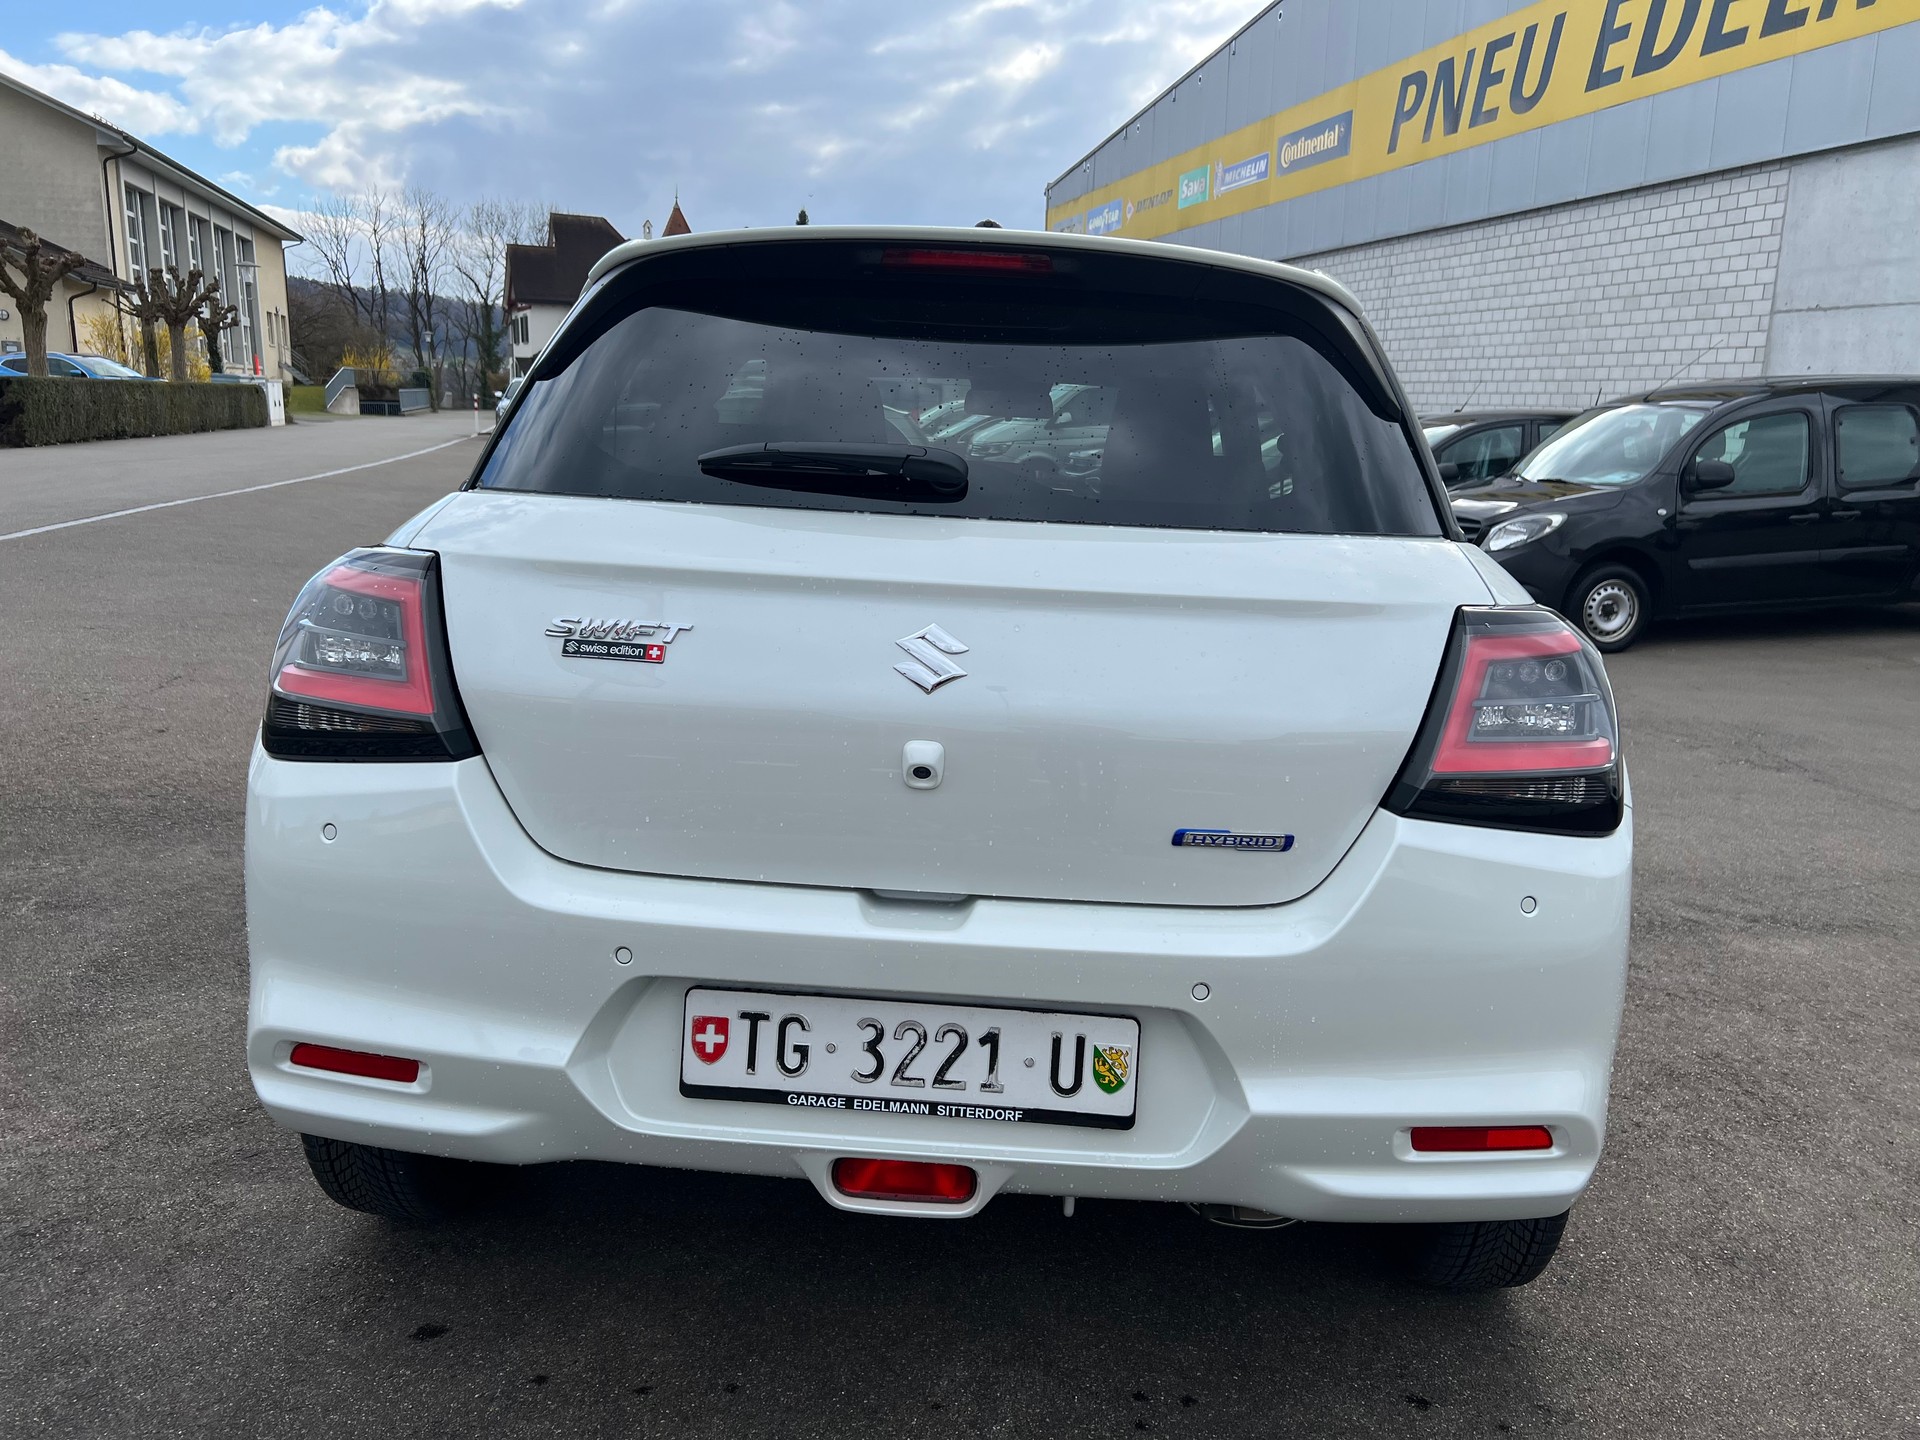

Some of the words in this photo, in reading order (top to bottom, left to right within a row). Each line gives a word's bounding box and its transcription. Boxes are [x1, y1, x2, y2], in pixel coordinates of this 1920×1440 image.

[1387, 11, 1568, 155] PNEU
[1280, 124, 1339, 169] Continental
[1224, 158, 1267, 183] MICHELIN
[1181, 176, 1206, 199] Sava
[545, 616, 694, 644] SWIFT
[580, 643, 608, 654] swiss
[611, 645, 644, 656] edition
[1191, 835, 1278, 847] HYBRID
[738, 1010, 812, 1078] TG
[851, 1017, 1005, 1093] 3221
[1050, 1031, 1086, 1098] U
[787, 1094, 846, 1109] GARAGE
[853, 1099, 930, 1115] EDELMANN
[936, 1105, 1023, 1121] SITTERDORF
